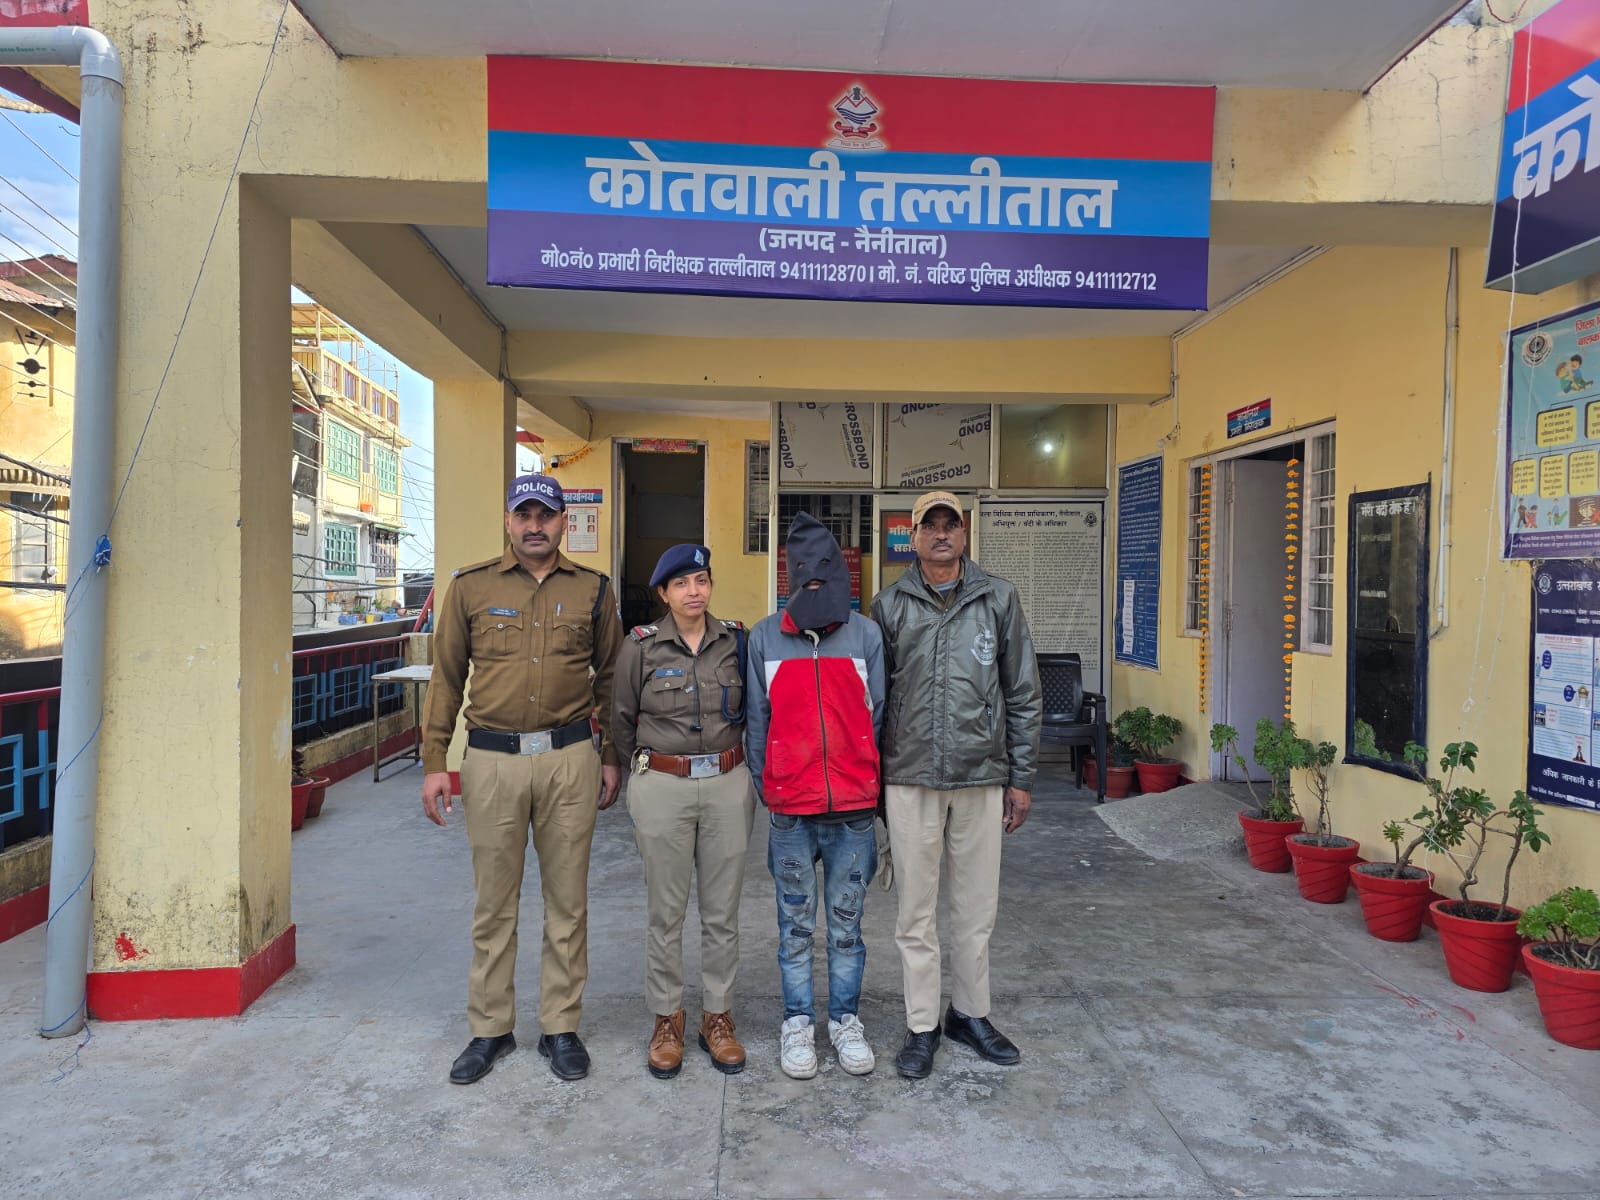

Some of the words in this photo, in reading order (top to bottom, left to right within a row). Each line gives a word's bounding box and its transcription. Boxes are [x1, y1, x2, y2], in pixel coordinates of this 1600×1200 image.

[585, 141, 845, 219] कोतवाली
[855, 157, 1118, 228] तल्लीताल
[759, 227, 836, 253] (जनपद
[854, 225, 947, 258] नैनीताल)
[598, 247, 641, 272] प्रभारी
[644, 249, 705, 275] निरीक्षक
[708, 253, 776, 278] तल्लीताल
[969, 262, 1011, 292] पुलिस
[1014, 263, 1072, 288] अधीक्षक
[1075, 271, 1157, 290] 9411112712
[515, 482, 554, 497] POLICE
[900, 463, 971, 488] CROSSBOND
[1556, 580, 1593, 592] उत्तराखण्ड
